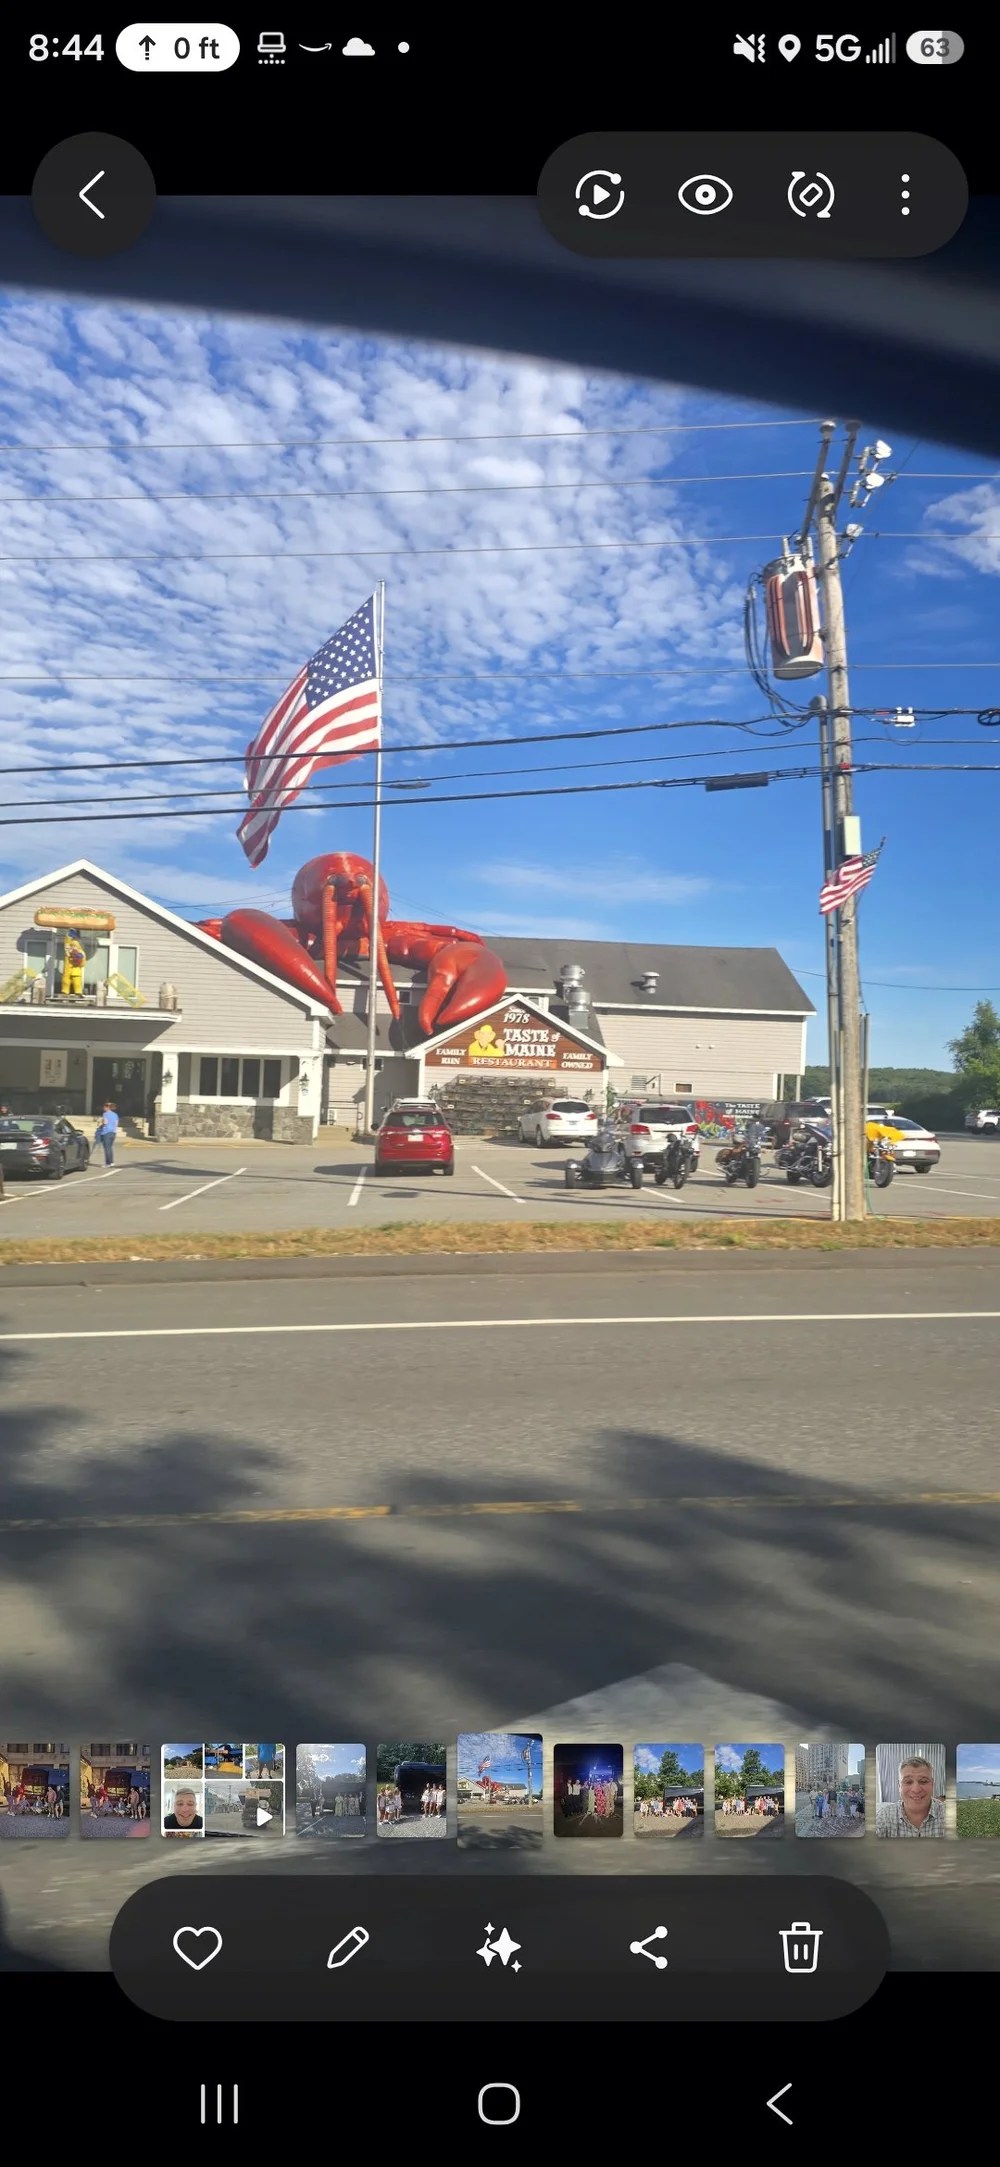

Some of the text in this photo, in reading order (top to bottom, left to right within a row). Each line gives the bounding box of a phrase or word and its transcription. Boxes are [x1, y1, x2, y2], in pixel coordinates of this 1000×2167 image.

[503, 1012, 530, 1024] 1978
[503, 1028, 549, 1042] TASTE
[436, 1048, 467, 1056] FAMILY
[504, 1043, 556, 1057] MAINE
[562, 1052, 594, 1060] FAMILY
[441, 1057, 460, 1065] RUN
[473, 1057, 550, 1068] RESTAURANT
[561, 1061, 594, 1069] OWNED
